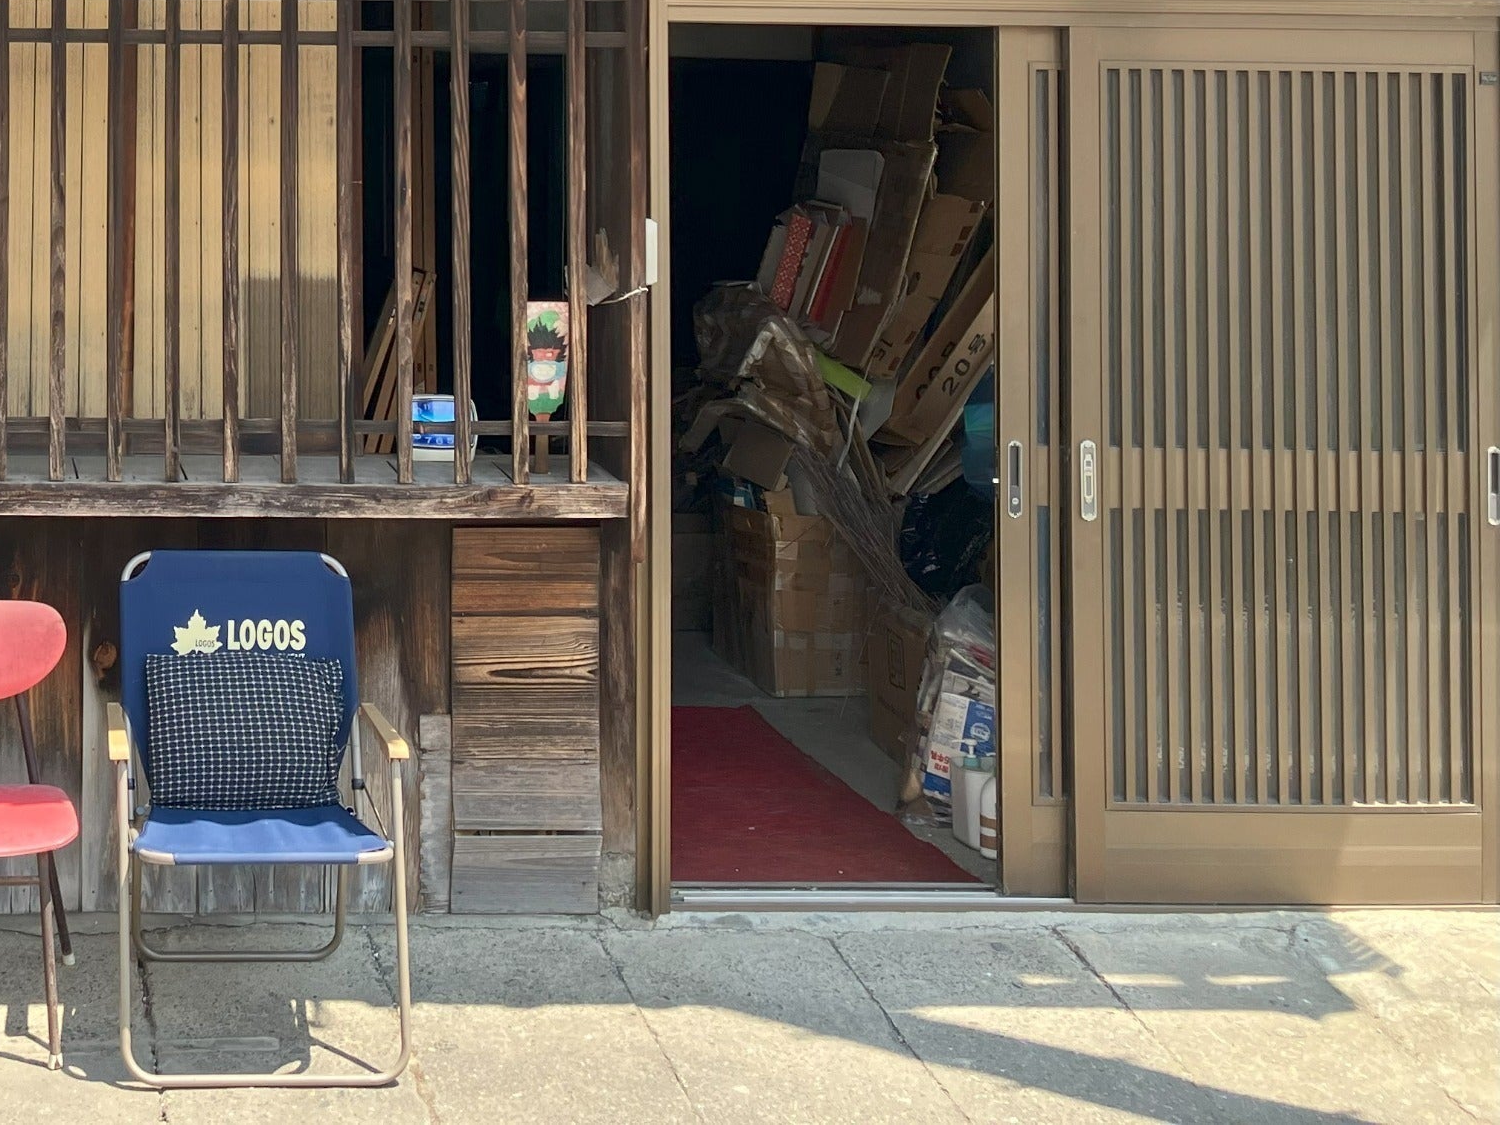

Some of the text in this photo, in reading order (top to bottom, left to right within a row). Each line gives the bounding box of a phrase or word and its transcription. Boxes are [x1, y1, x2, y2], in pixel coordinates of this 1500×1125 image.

[942, 334, 986, 397] 20号
[195, 639, 215, 648] LOGOS
[227, 619, 307, 651] LOGOS
